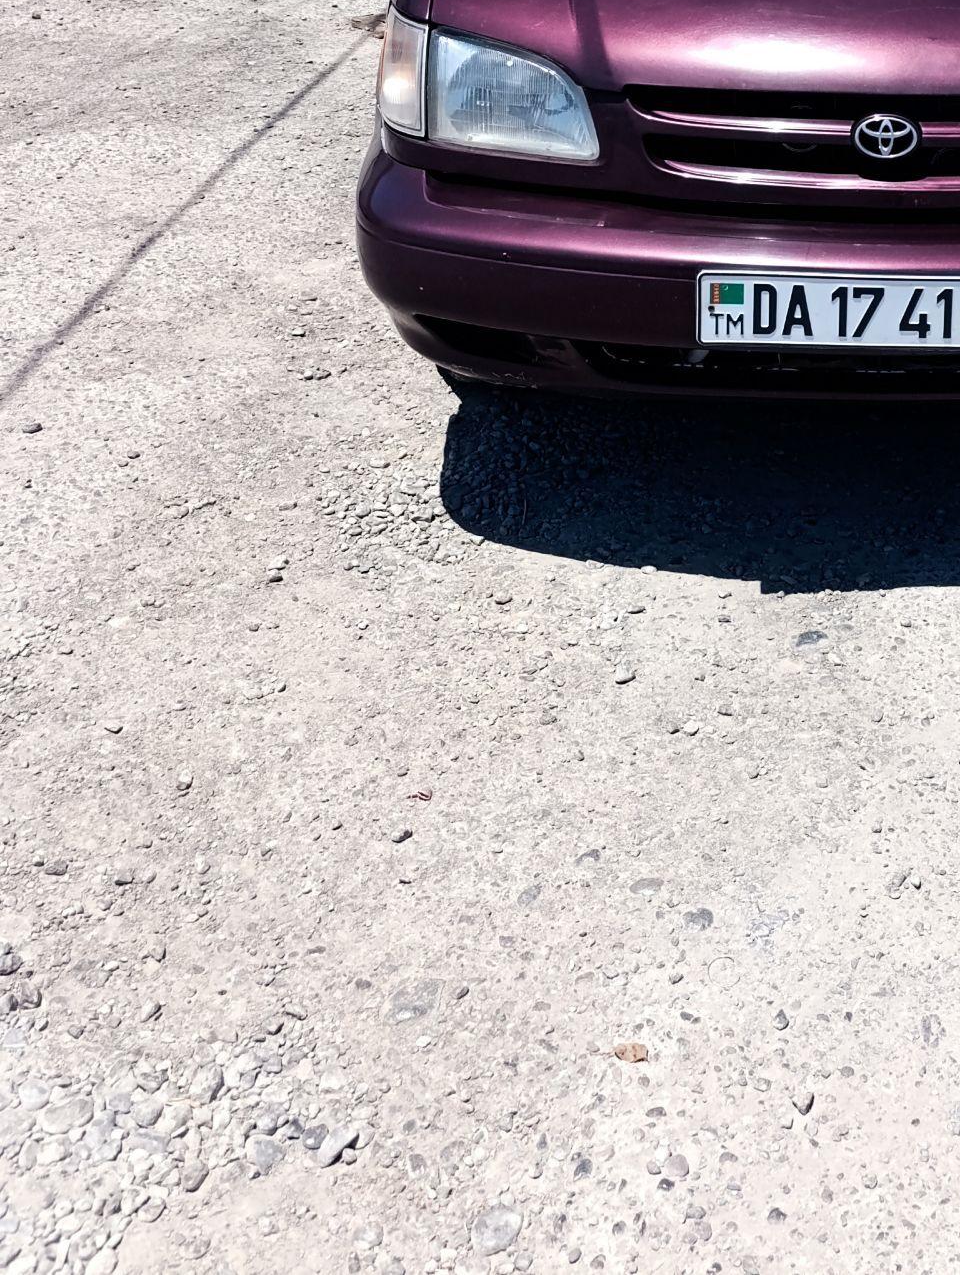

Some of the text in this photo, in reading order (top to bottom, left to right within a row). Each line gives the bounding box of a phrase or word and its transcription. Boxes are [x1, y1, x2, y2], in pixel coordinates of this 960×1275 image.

[709, 313, 744, 335] TM
[753, 283, 814, 336] DA
[831, 286, 885, 338] 17
[899, 288, 954, 339] 41
